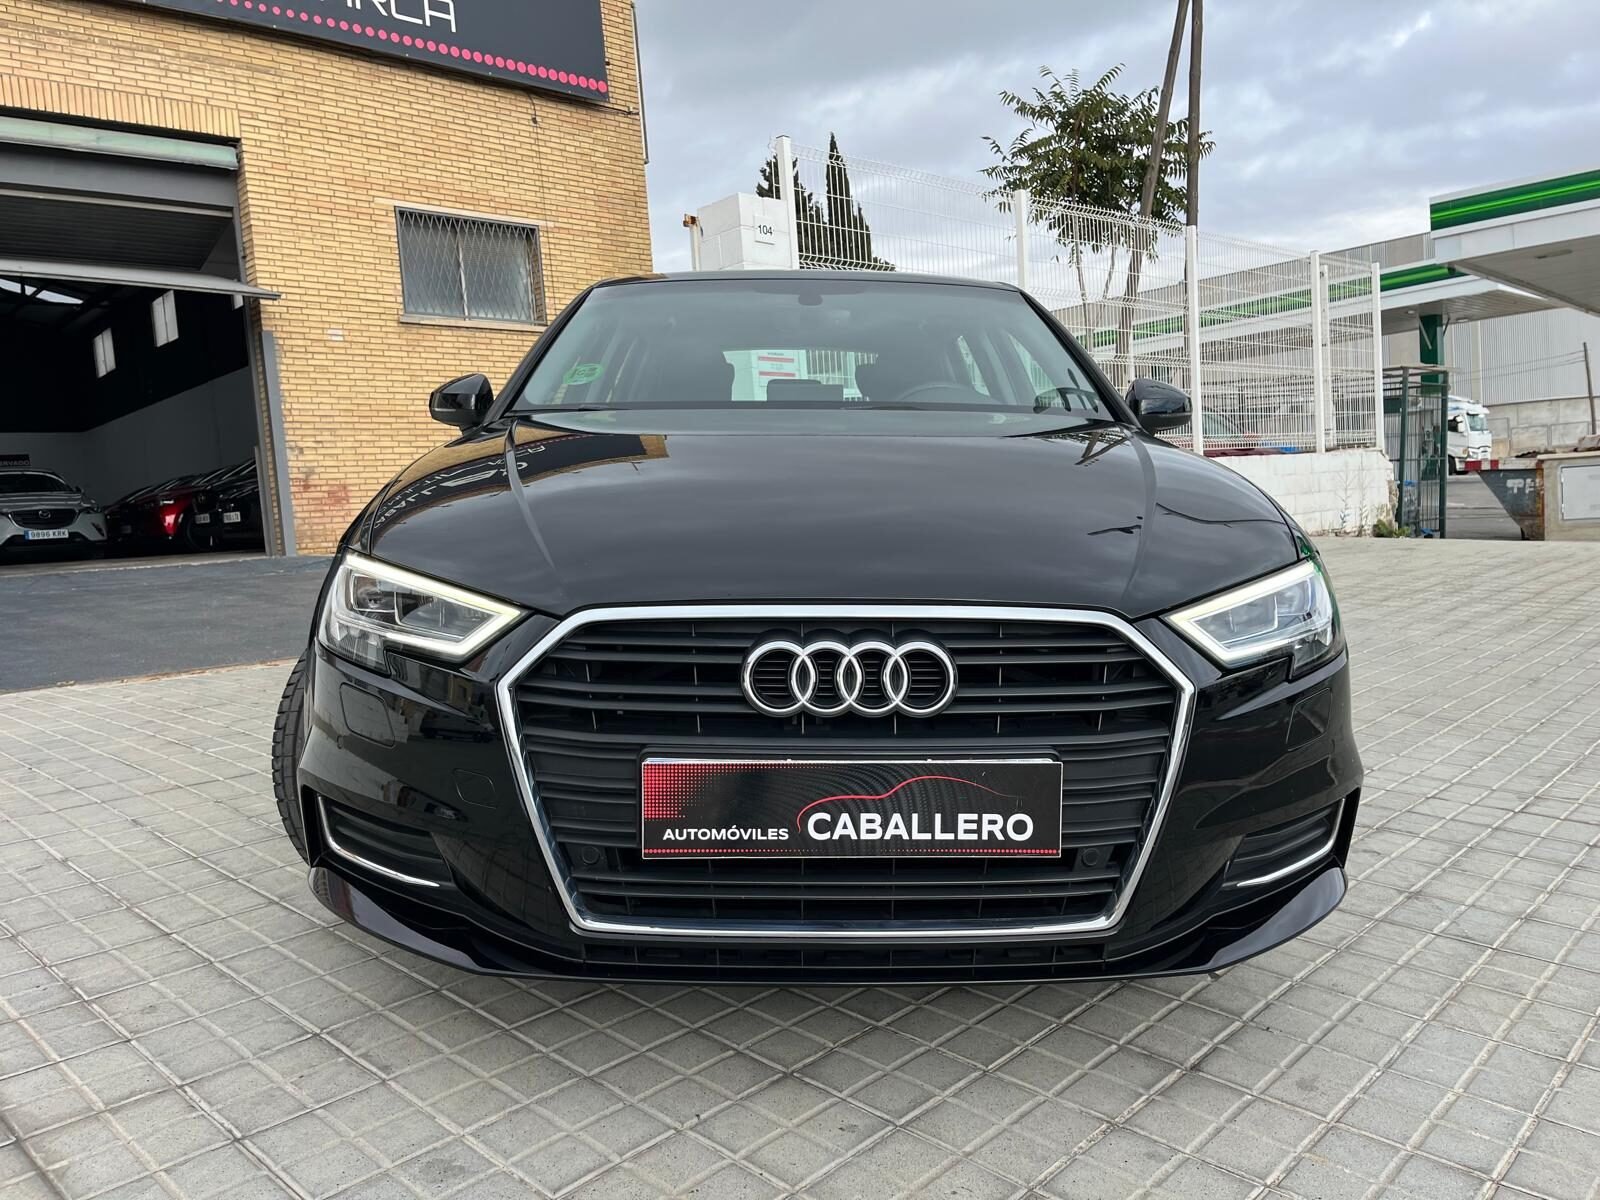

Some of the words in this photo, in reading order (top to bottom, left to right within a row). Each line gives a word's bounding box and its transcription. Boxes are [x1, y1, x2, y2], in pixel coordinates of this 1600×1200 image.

[758, 224, 772, 236] 104
[662, 825, 789, 841] AUTOMÓVILES
[807, 812, 1034, 841] CABALLERO
